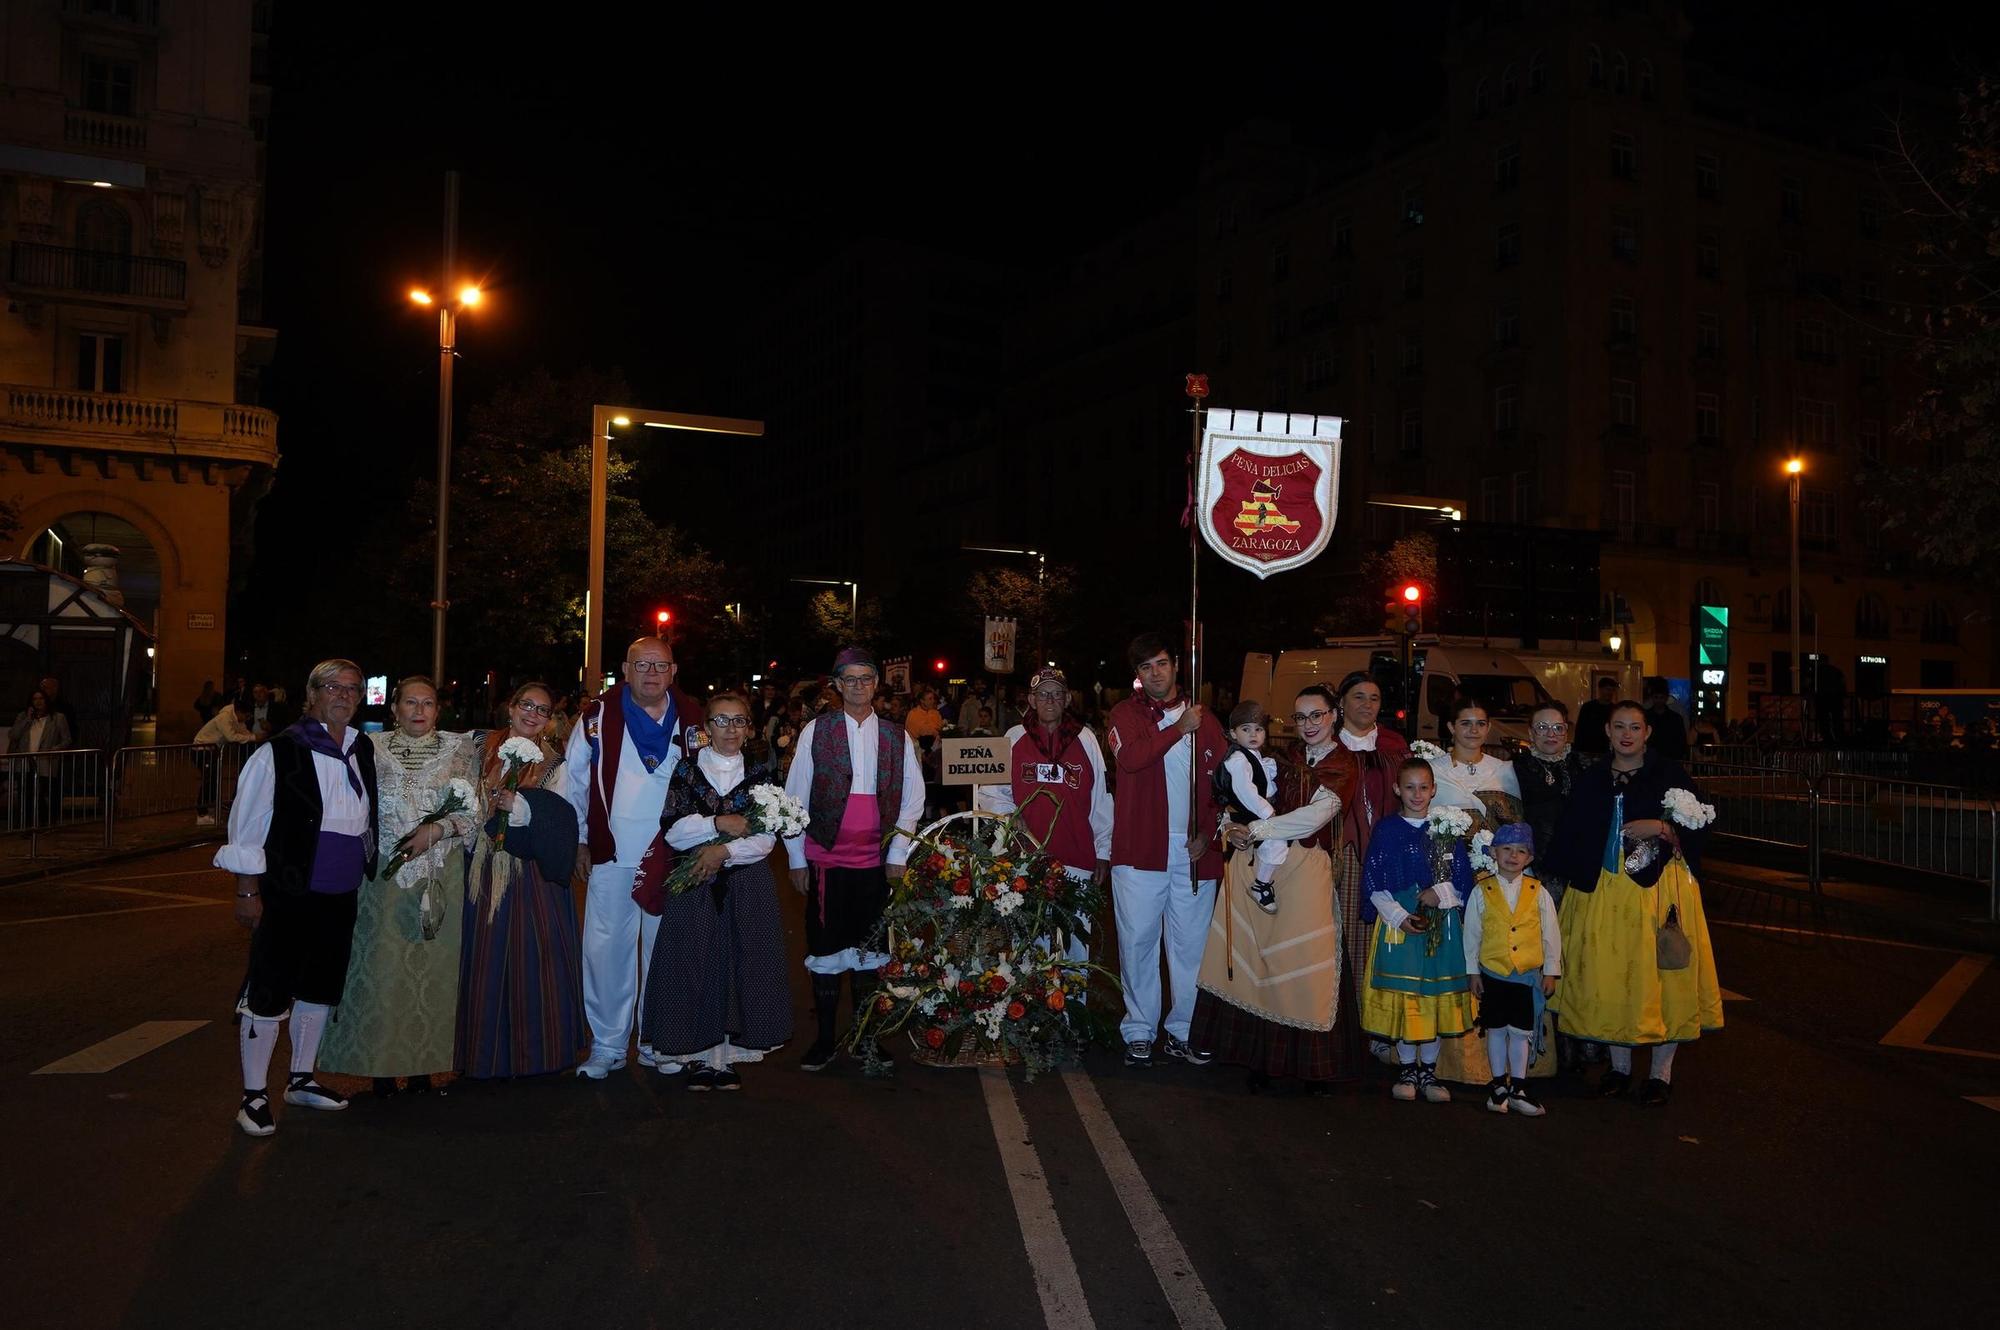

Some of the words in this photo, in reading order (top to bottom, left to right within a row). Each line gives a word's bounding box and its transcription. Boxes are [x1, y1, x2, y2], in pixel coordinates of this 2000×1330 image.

[1262, 457, 1310, 477] DELICIAS
[1232, 537, 1301, 551] ZARAGOZA
[1860, 655, 1886, 664] SEPHORA
[960, 746, 993, 758] PEÑA
[949, 763, 1005, 774] DELICIAS
